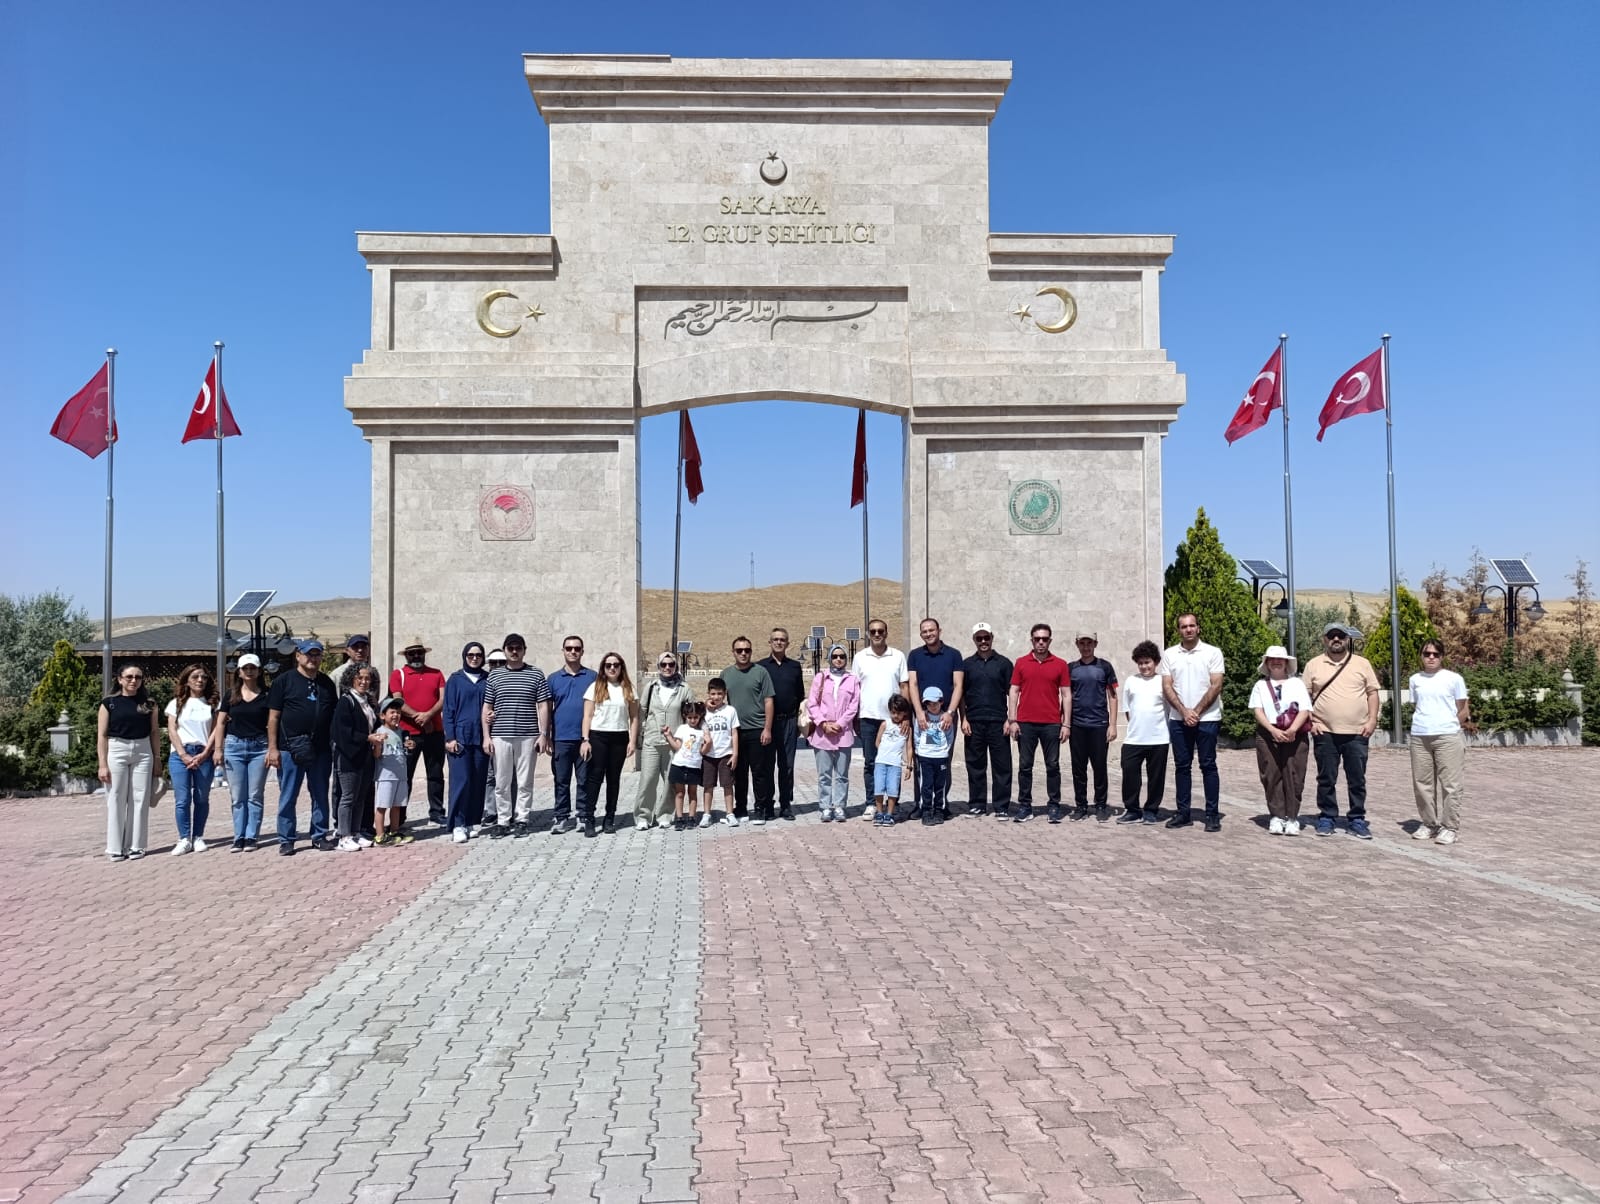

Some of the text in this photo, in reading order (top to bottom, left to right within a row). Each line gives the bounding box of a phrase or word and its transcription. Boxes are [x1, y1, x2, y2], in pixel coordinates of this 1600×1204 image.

[720, 195, 826, 215] SAKARYA
[667, 222, 876, 247] 12. GRUP ŞEHİTLİĞİ
